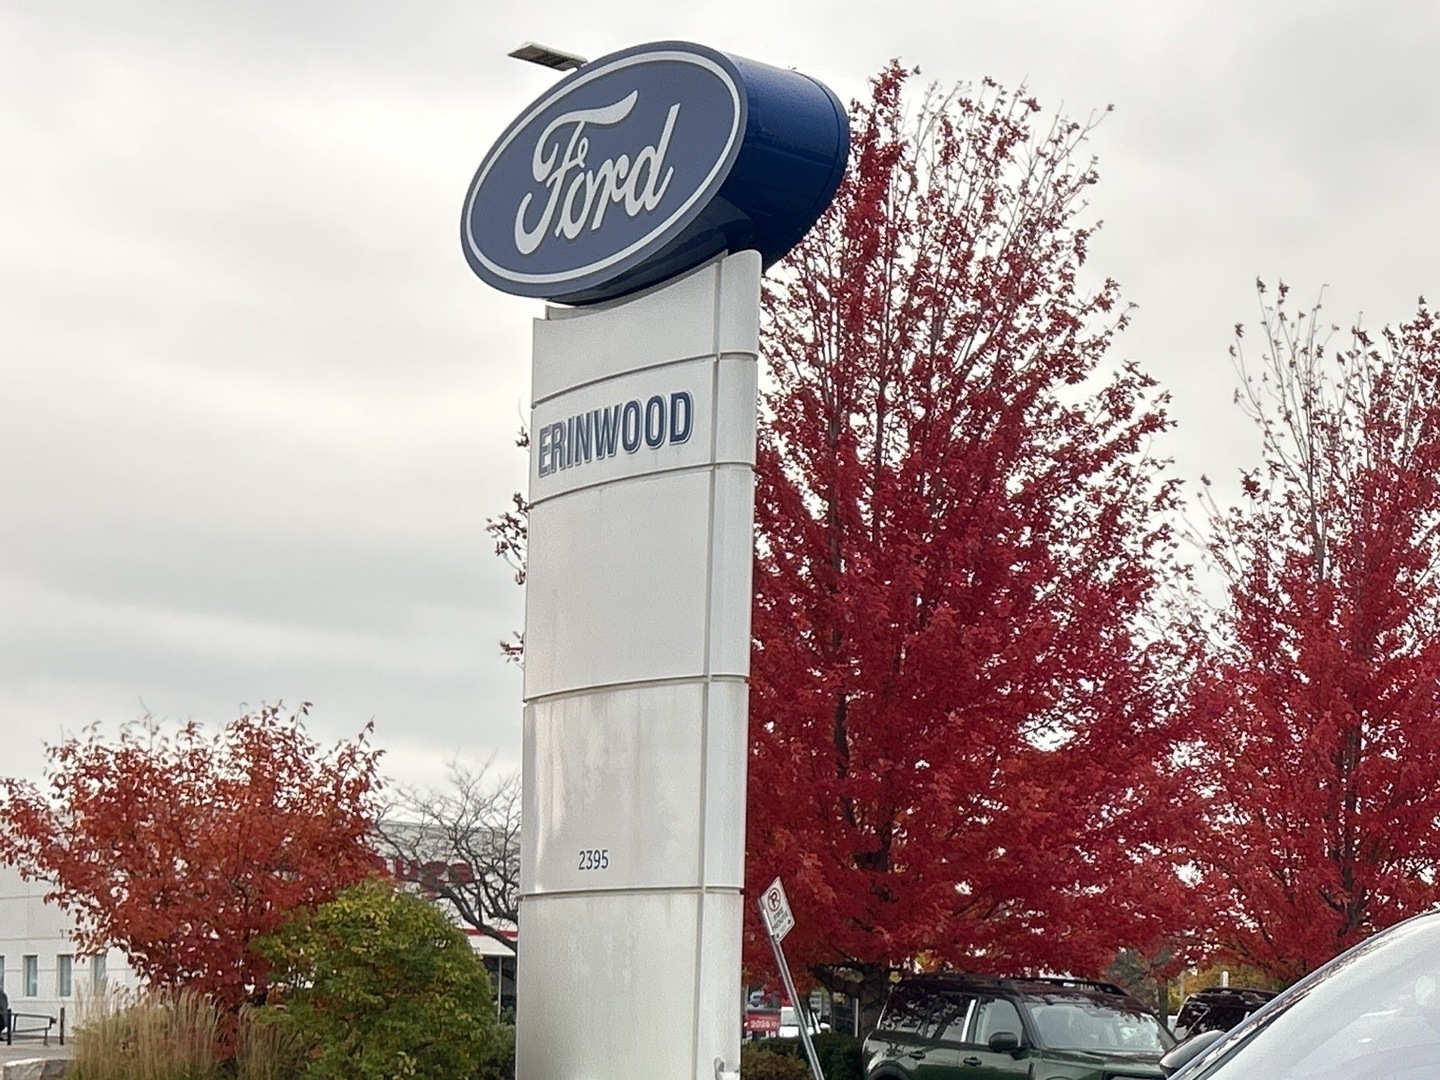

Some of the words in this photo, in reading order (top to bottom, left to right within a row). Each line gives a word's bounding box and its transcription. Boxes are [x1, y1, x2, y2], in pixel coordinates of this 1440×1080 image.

[514, 90, 681, 255] Ford
[538, 390, 694, 478] ERINWOOD
[578, 849, 609, 870] 2395
